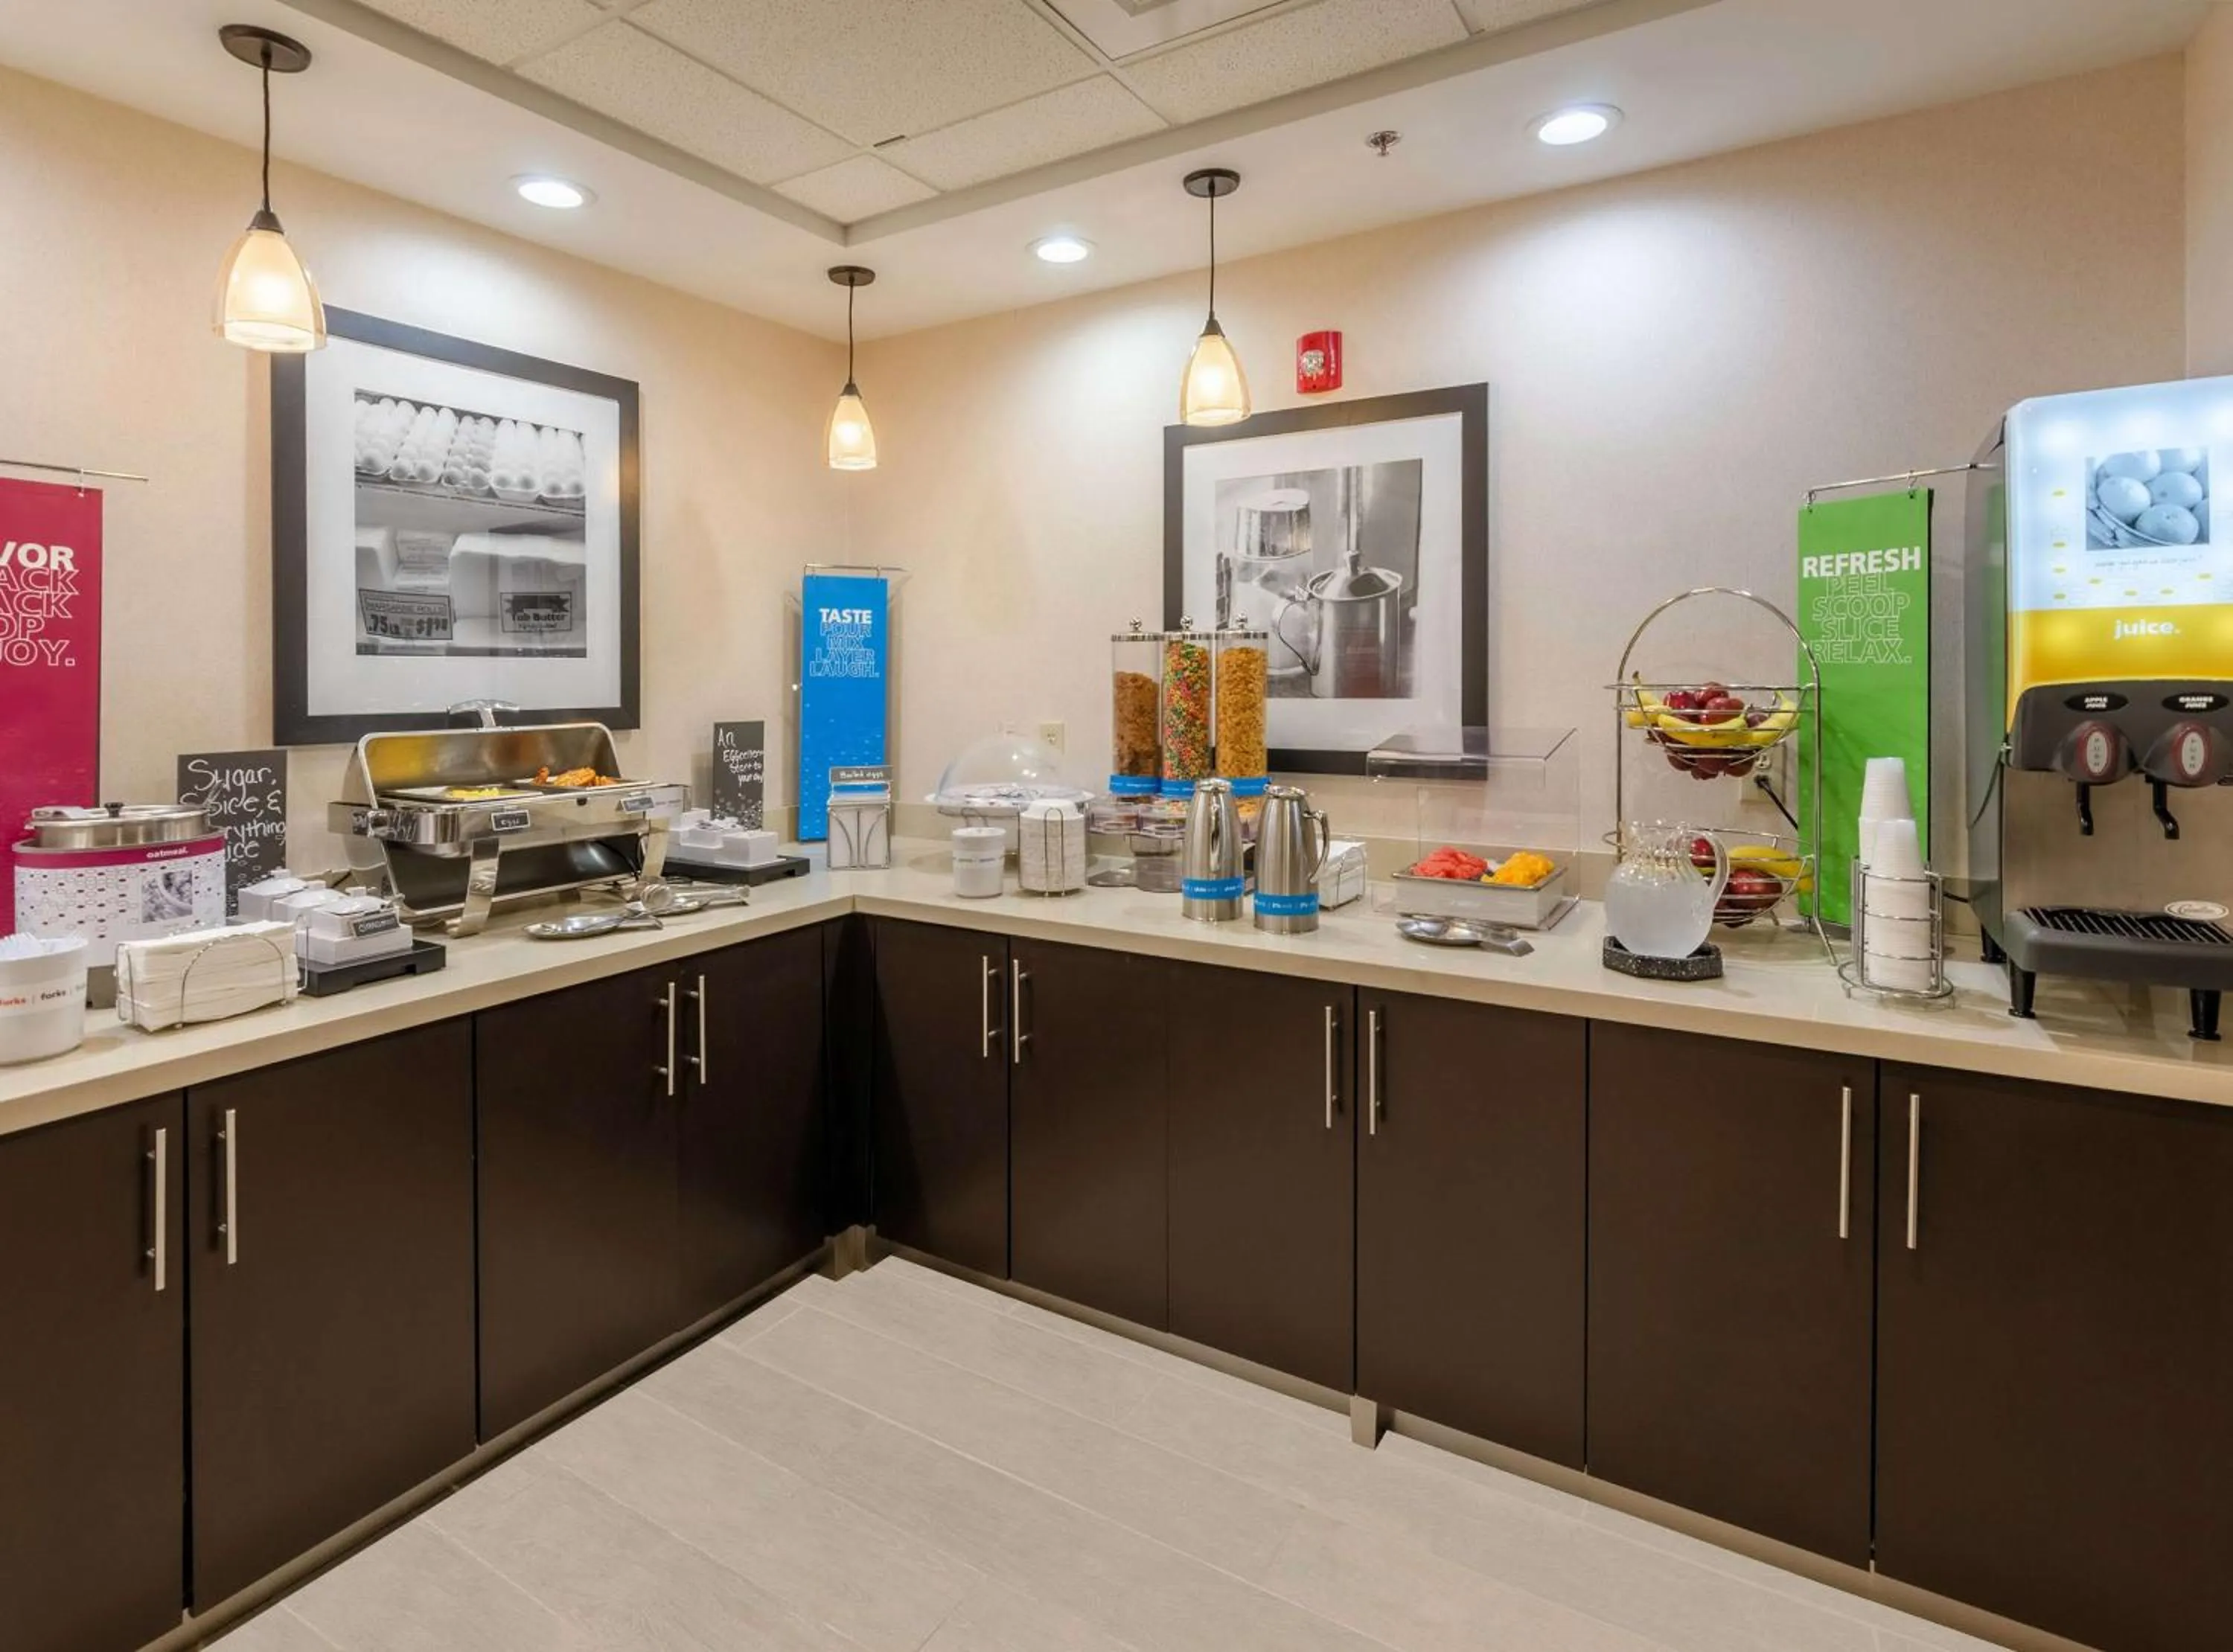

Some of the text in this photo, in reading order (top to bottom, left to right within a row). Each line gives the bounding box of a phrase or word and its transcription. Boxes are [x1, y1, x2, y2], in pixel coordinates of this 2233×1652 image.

[1802, 546, 1921, 578] REFRESH
[1826, 572, 1896, 596] PEEL
[819, 608, 872, 624] TASTE
[1812, 592, 1911, 621] SCOOP
[820, 622, 872, 637] POUR
[1821, 616, 1900, 643] SLICE
[0, 638, 75, 667] OY.
[827, 635, 864, 650] MIX
[1809, 638, 1912, 664] RELAX.
[816, 647, 875, 663] LAYER
[809, 661, 880, 678] LAUGH.
[718, 727, 737, 749] An
[226, 841, 260, 862] ice
